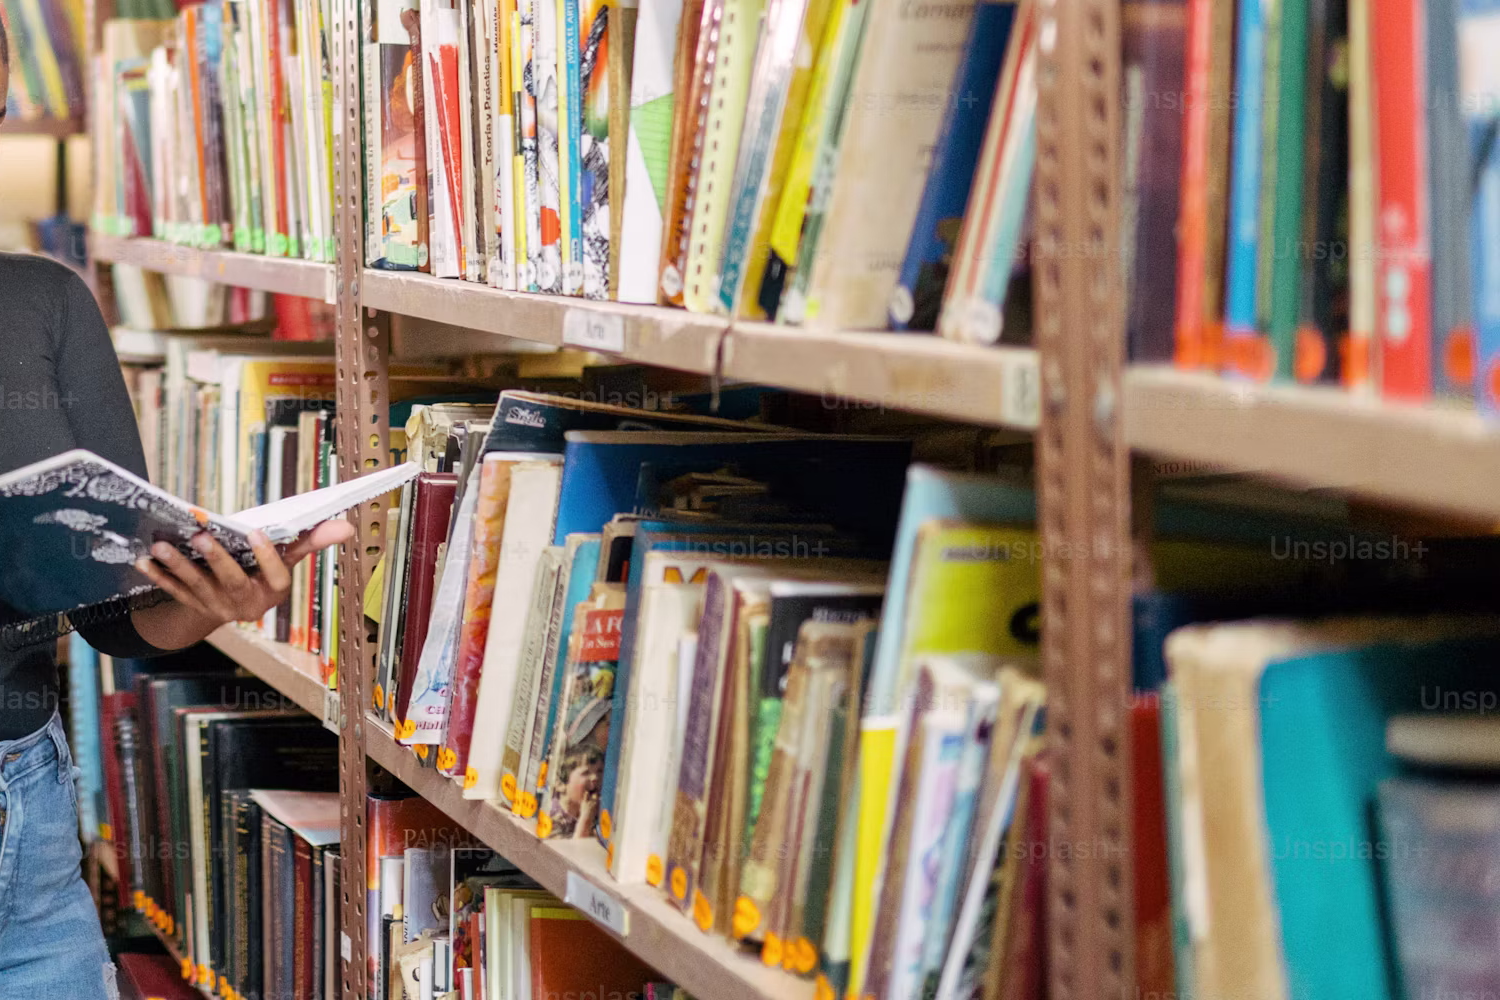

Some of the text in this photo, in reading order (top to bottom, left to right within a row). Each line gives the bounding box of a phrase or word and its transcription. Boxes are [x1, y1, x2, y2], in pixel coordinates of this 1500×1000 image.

[567, 26, 574, 36] EL
[483, 55, 492, 166] Teoría y Práctica
[590, 893, 610, 921] Arte
